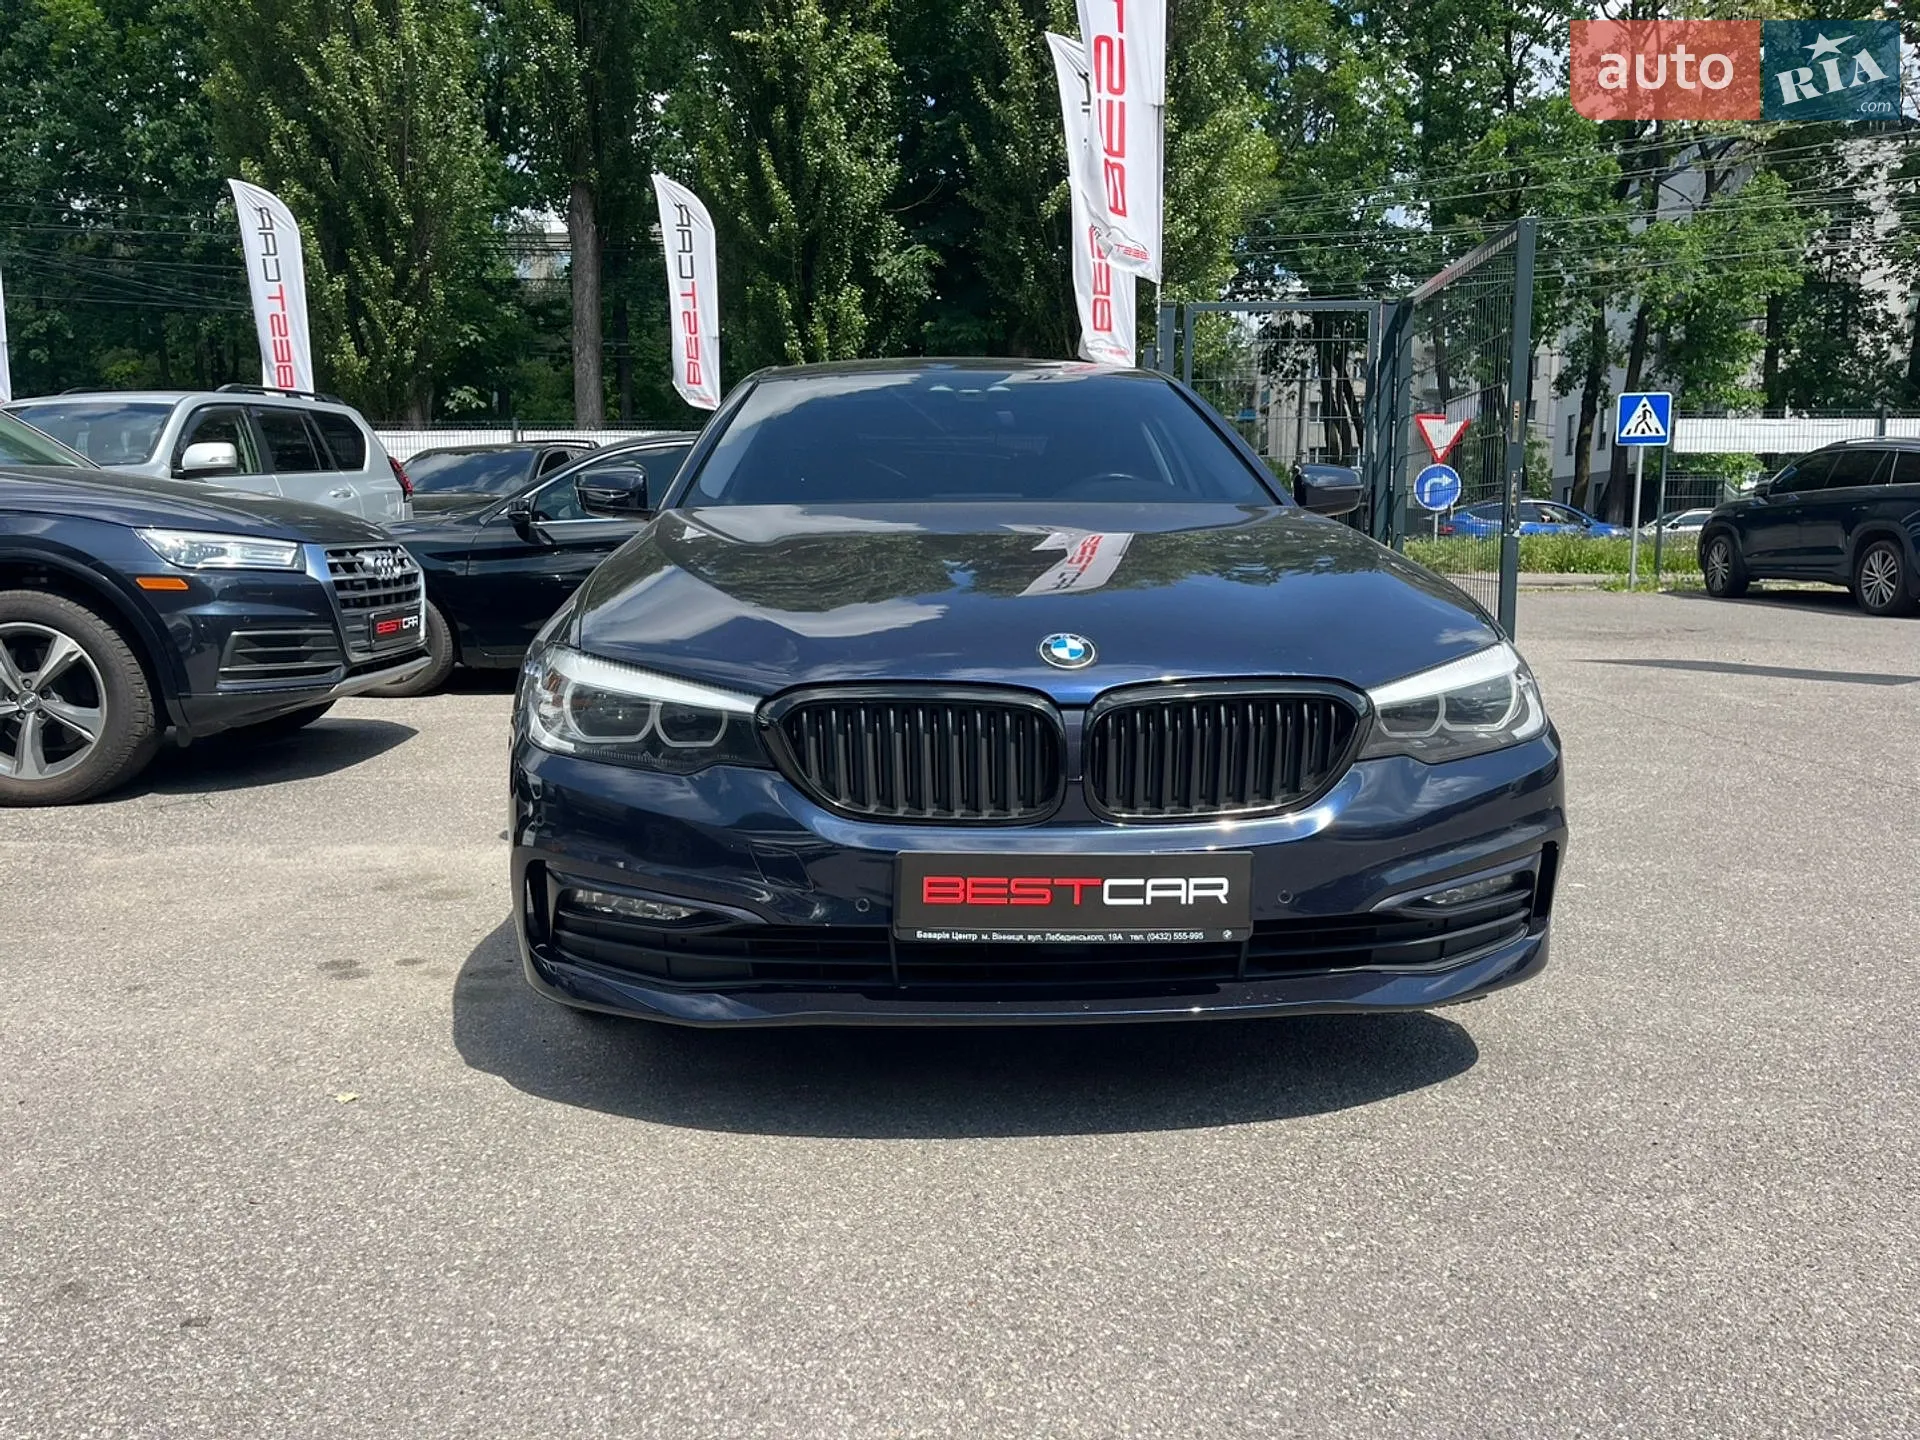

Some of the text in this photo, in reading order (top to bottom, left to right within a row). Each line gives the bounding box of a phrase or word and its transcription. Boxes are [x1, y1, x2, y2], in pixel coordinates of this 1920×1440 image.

[376, 615, 419, 634] BESTCAR
[922, 876, 1229, 905] BESTCAR
[951, 931, 978, 942] Центр
